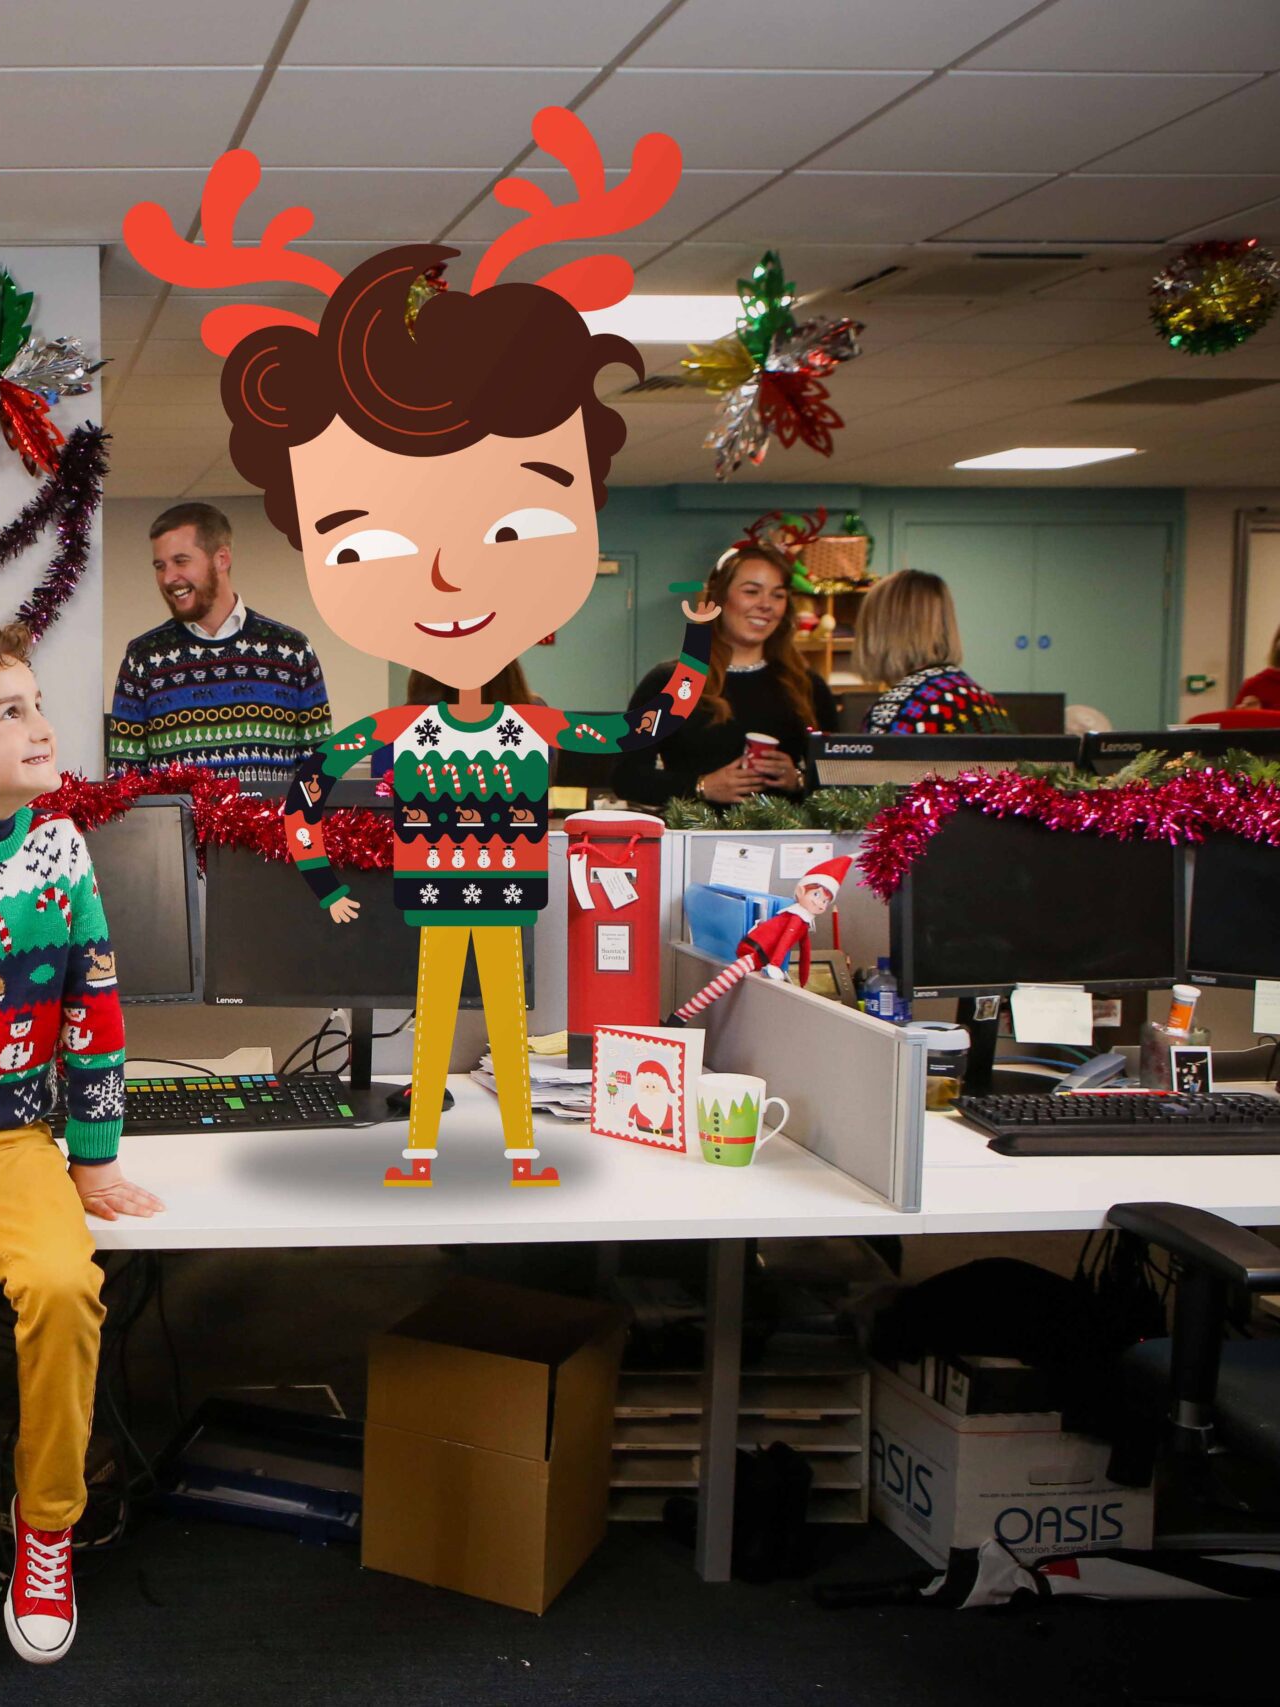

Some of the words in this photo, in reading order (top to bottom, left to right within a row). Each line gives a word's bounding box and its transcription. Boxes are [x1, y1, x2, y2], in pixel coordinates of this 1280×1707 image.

[825, 742, 874, 753] Lenovo
[1101, 742, 1142, 752] Lenovo
[871, 1430, 933, 1517] ASIS
[995, 1503, 1123, 1545] OASIS
